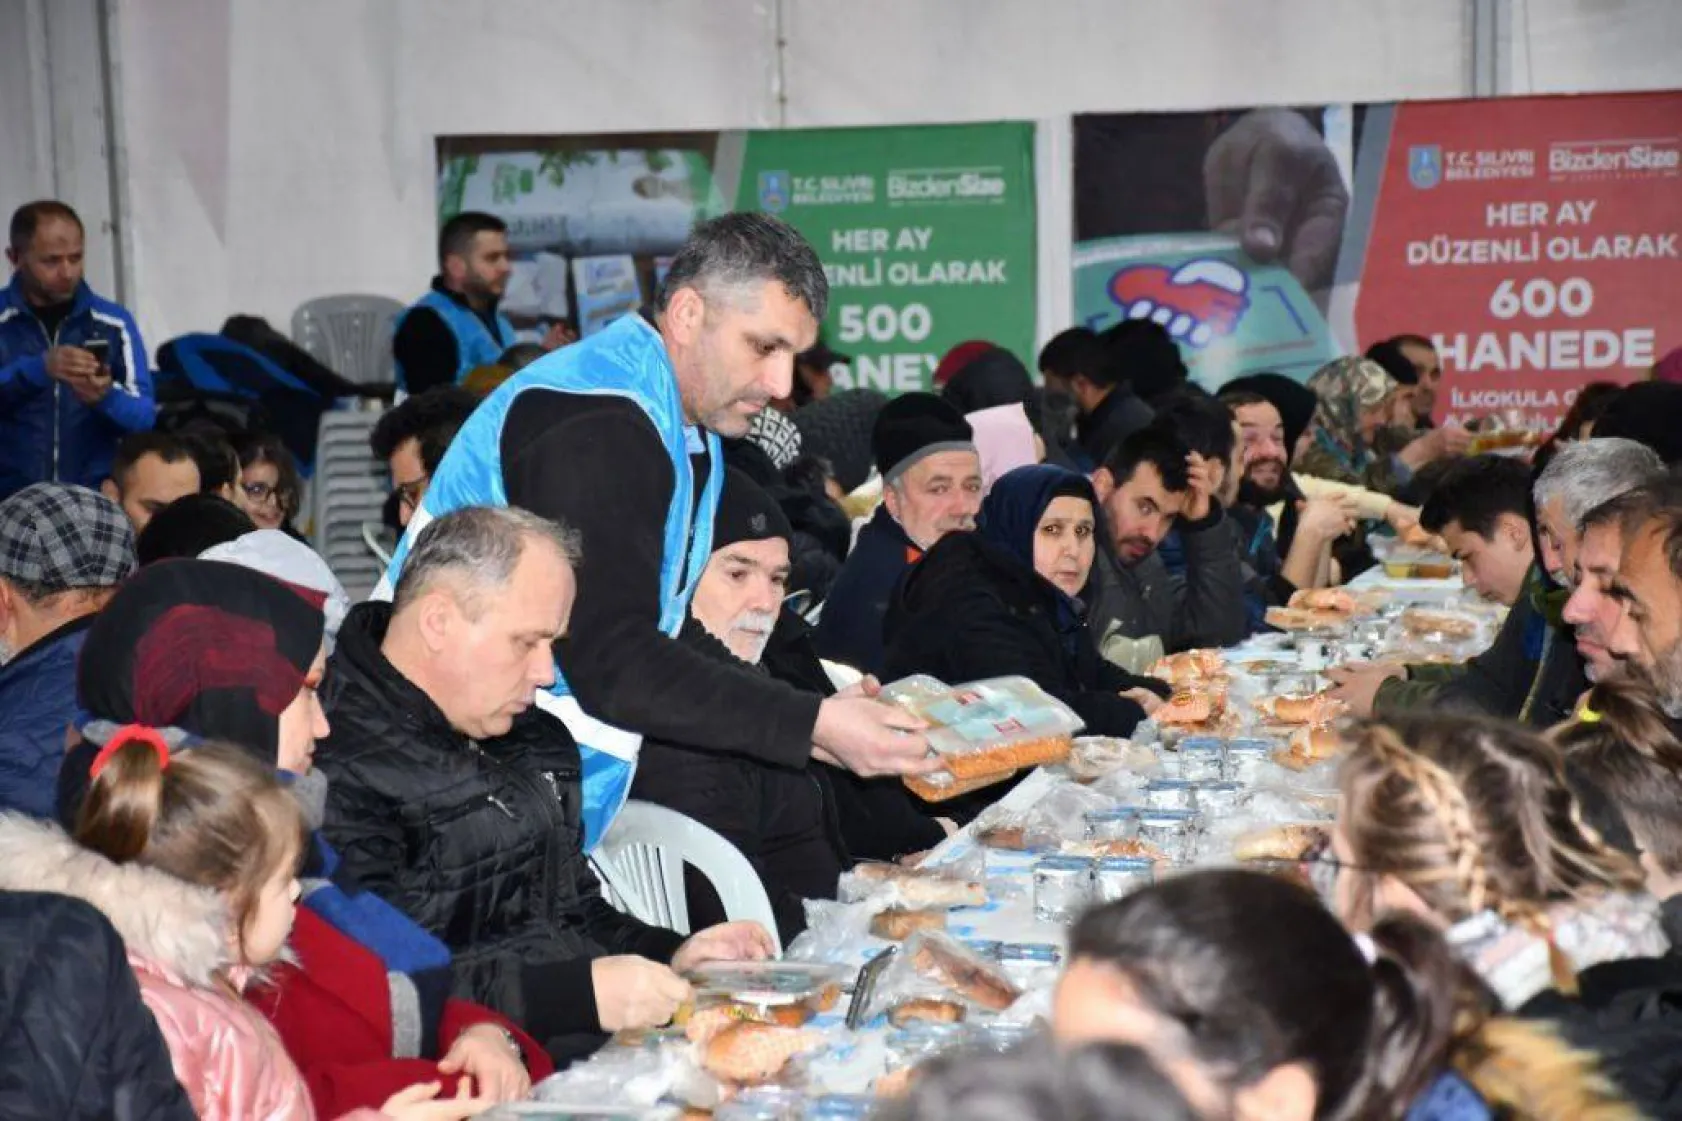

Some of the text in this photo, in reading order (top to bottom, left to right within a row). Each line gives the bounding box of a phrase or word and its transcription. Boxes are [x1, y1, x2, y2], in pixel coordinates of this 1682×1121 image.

[1486, 200, 1597, 227] HER AY
[832, 227, 933, 251] HER AY
[1406, 233, 1678, 265] DÜZENLİ OLARAK
[823, 257, 1006, 287] ENLİ OLARAK
[1489, 277, 1594, 319] 600
[838, 303, 933, 343] 500
[1431, 329, 1655, 372] HANEDE
